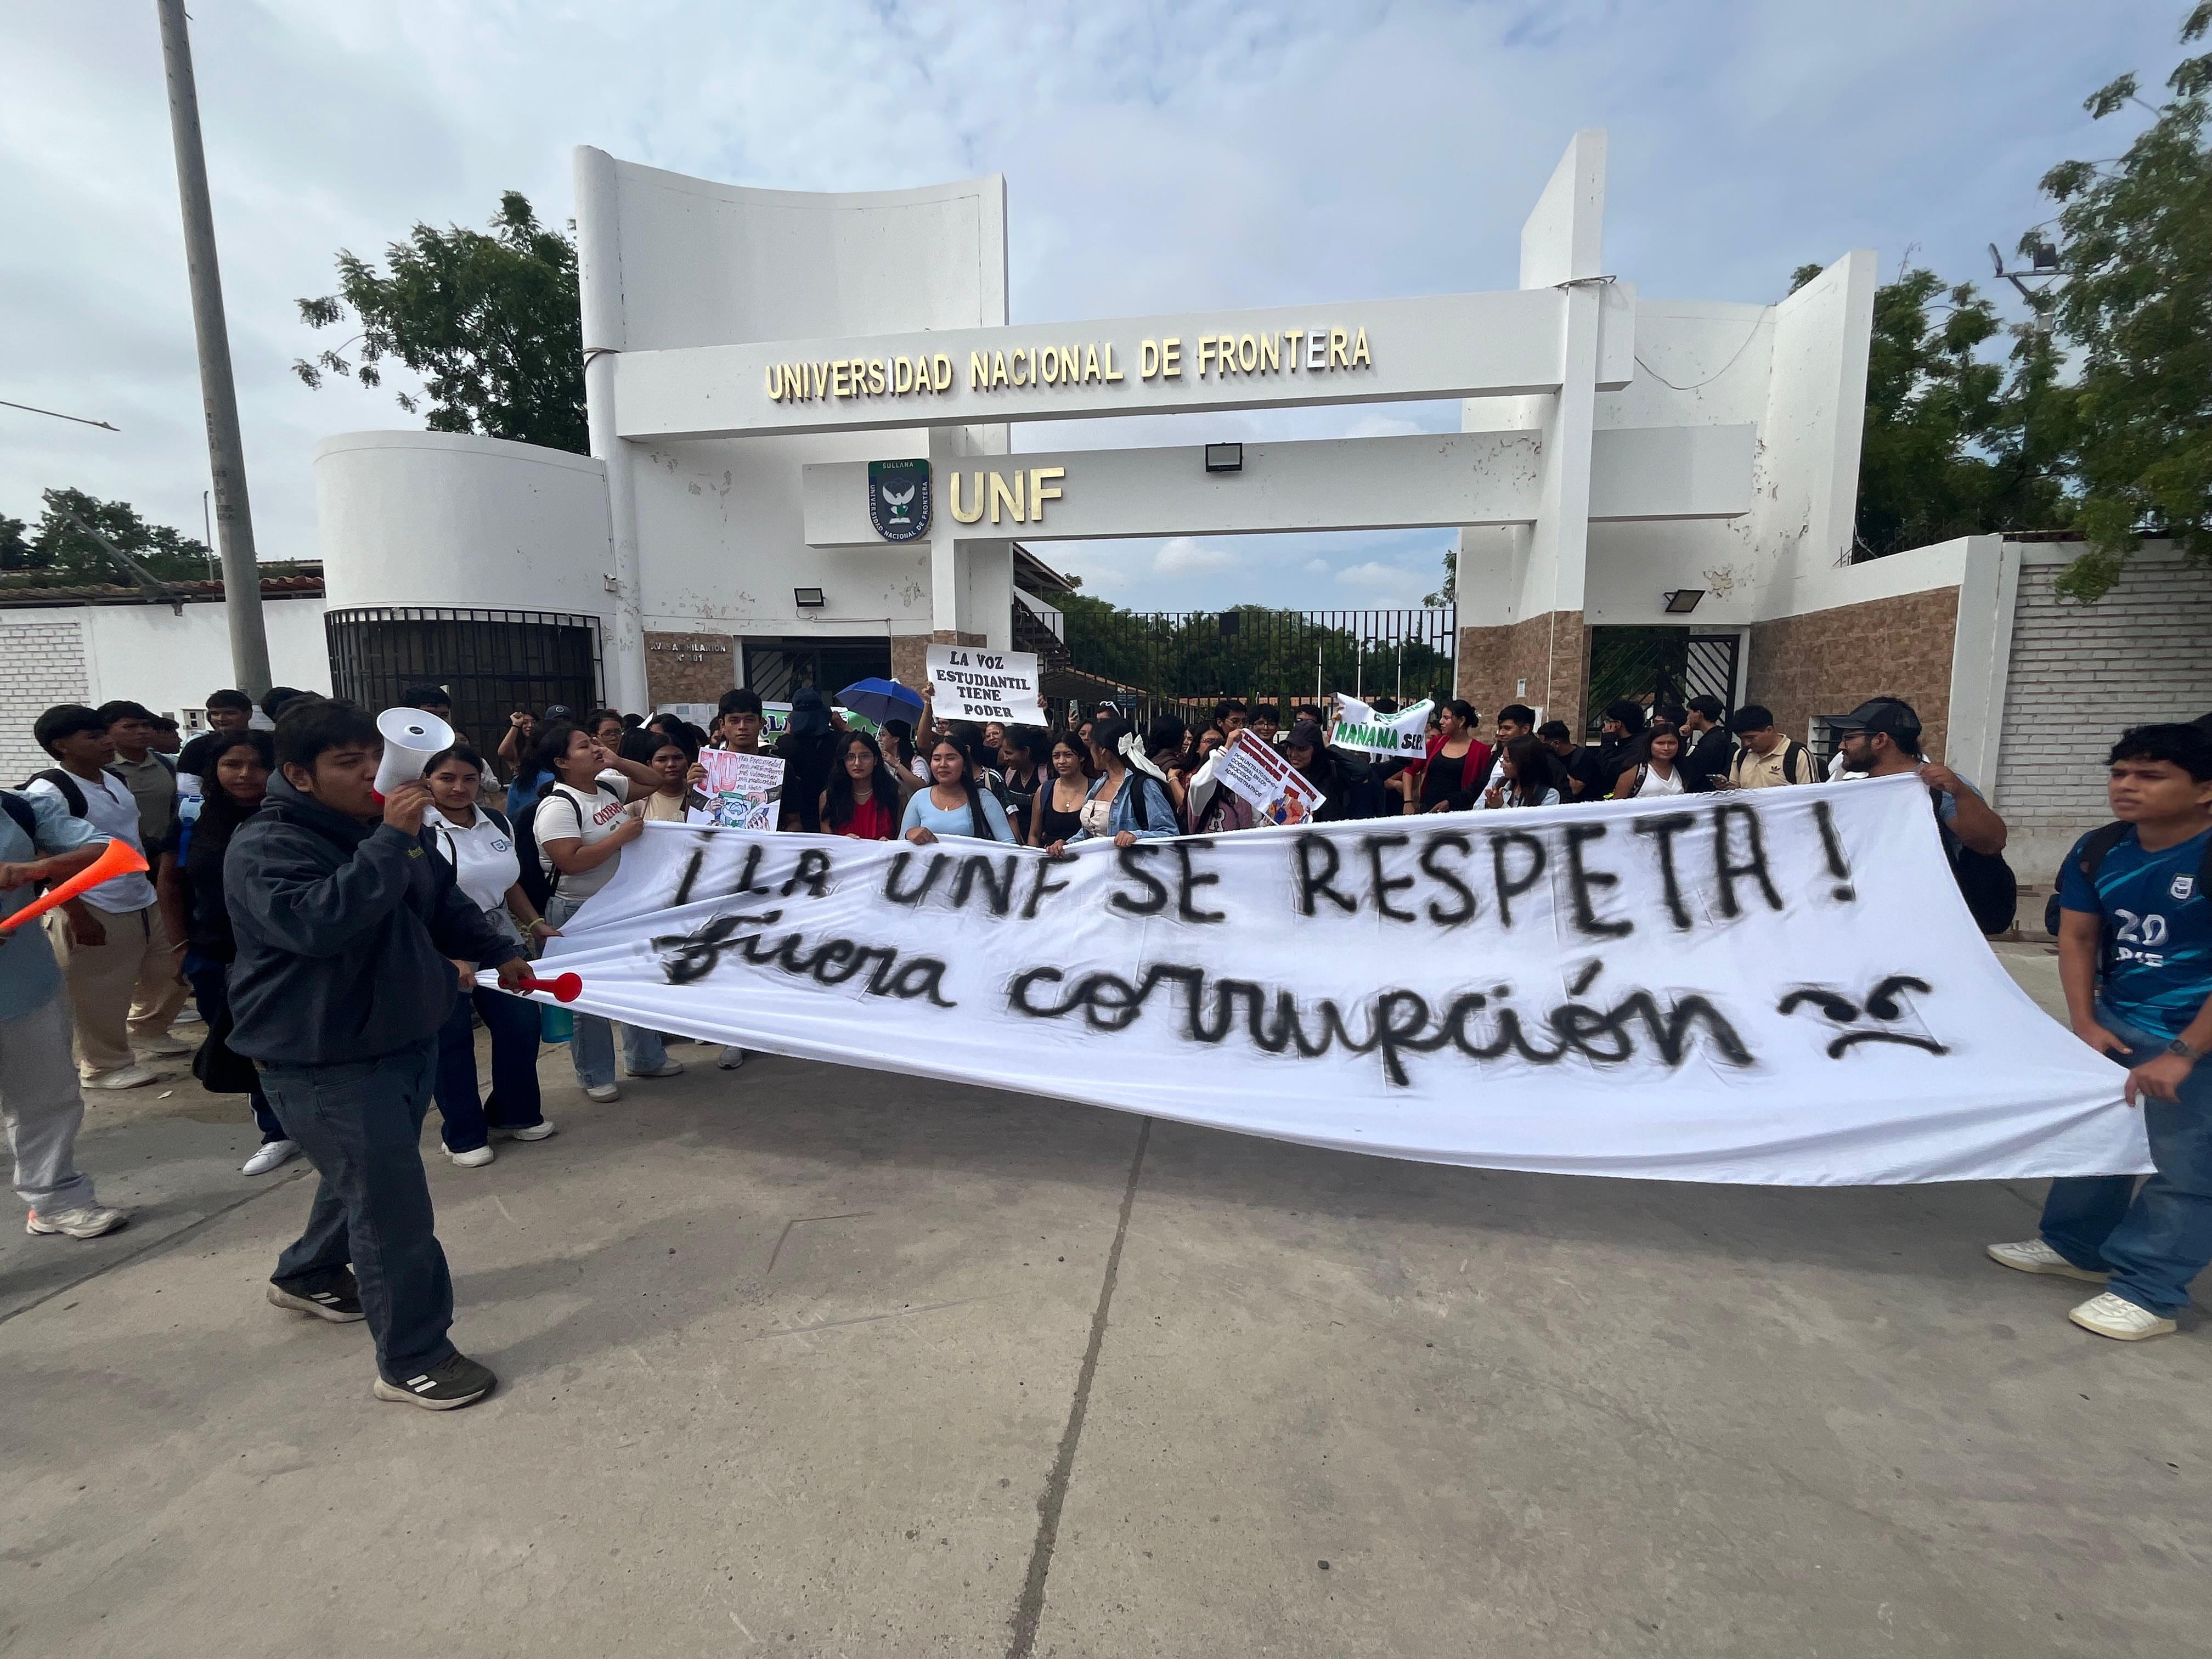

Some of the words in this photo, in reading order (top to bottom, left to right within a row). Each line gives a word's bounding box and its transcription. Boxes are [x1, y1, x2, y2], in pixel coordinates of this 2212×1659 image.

[766, 352, 953, 401] UNIVERSIDAD
[970, 342, 1124, 392] NACIONAL
[1141, 336, 1181, 378] DE
[1198, 327, 1371, 375] FRONTERA
[870, 484, 883, 531] UNIVERSIDAD
[884, 530, 916, 539] NACIONAL
[916, 522, 924, 531] DE
[951, 466, 1066, 523] UNF
[936, 669, 1031, 690] ESTUDIANTIL
[950, 651, 969, 666] LA
[977, 653, 1004, 669] VOZ
[957, 686, 1002, 701] TIENE
[963, 704, 1014, 718] PODER
[1334, 721, 1399, 751] MAÑANA
[697, 751, 738, 794] NO
[884, 850, 1080, 918] UNF
[1111, 834, 1226, 924] SE
[2114, 909, 2168, 946] 20
[1008, 960, 1754, 1086] corrupción
